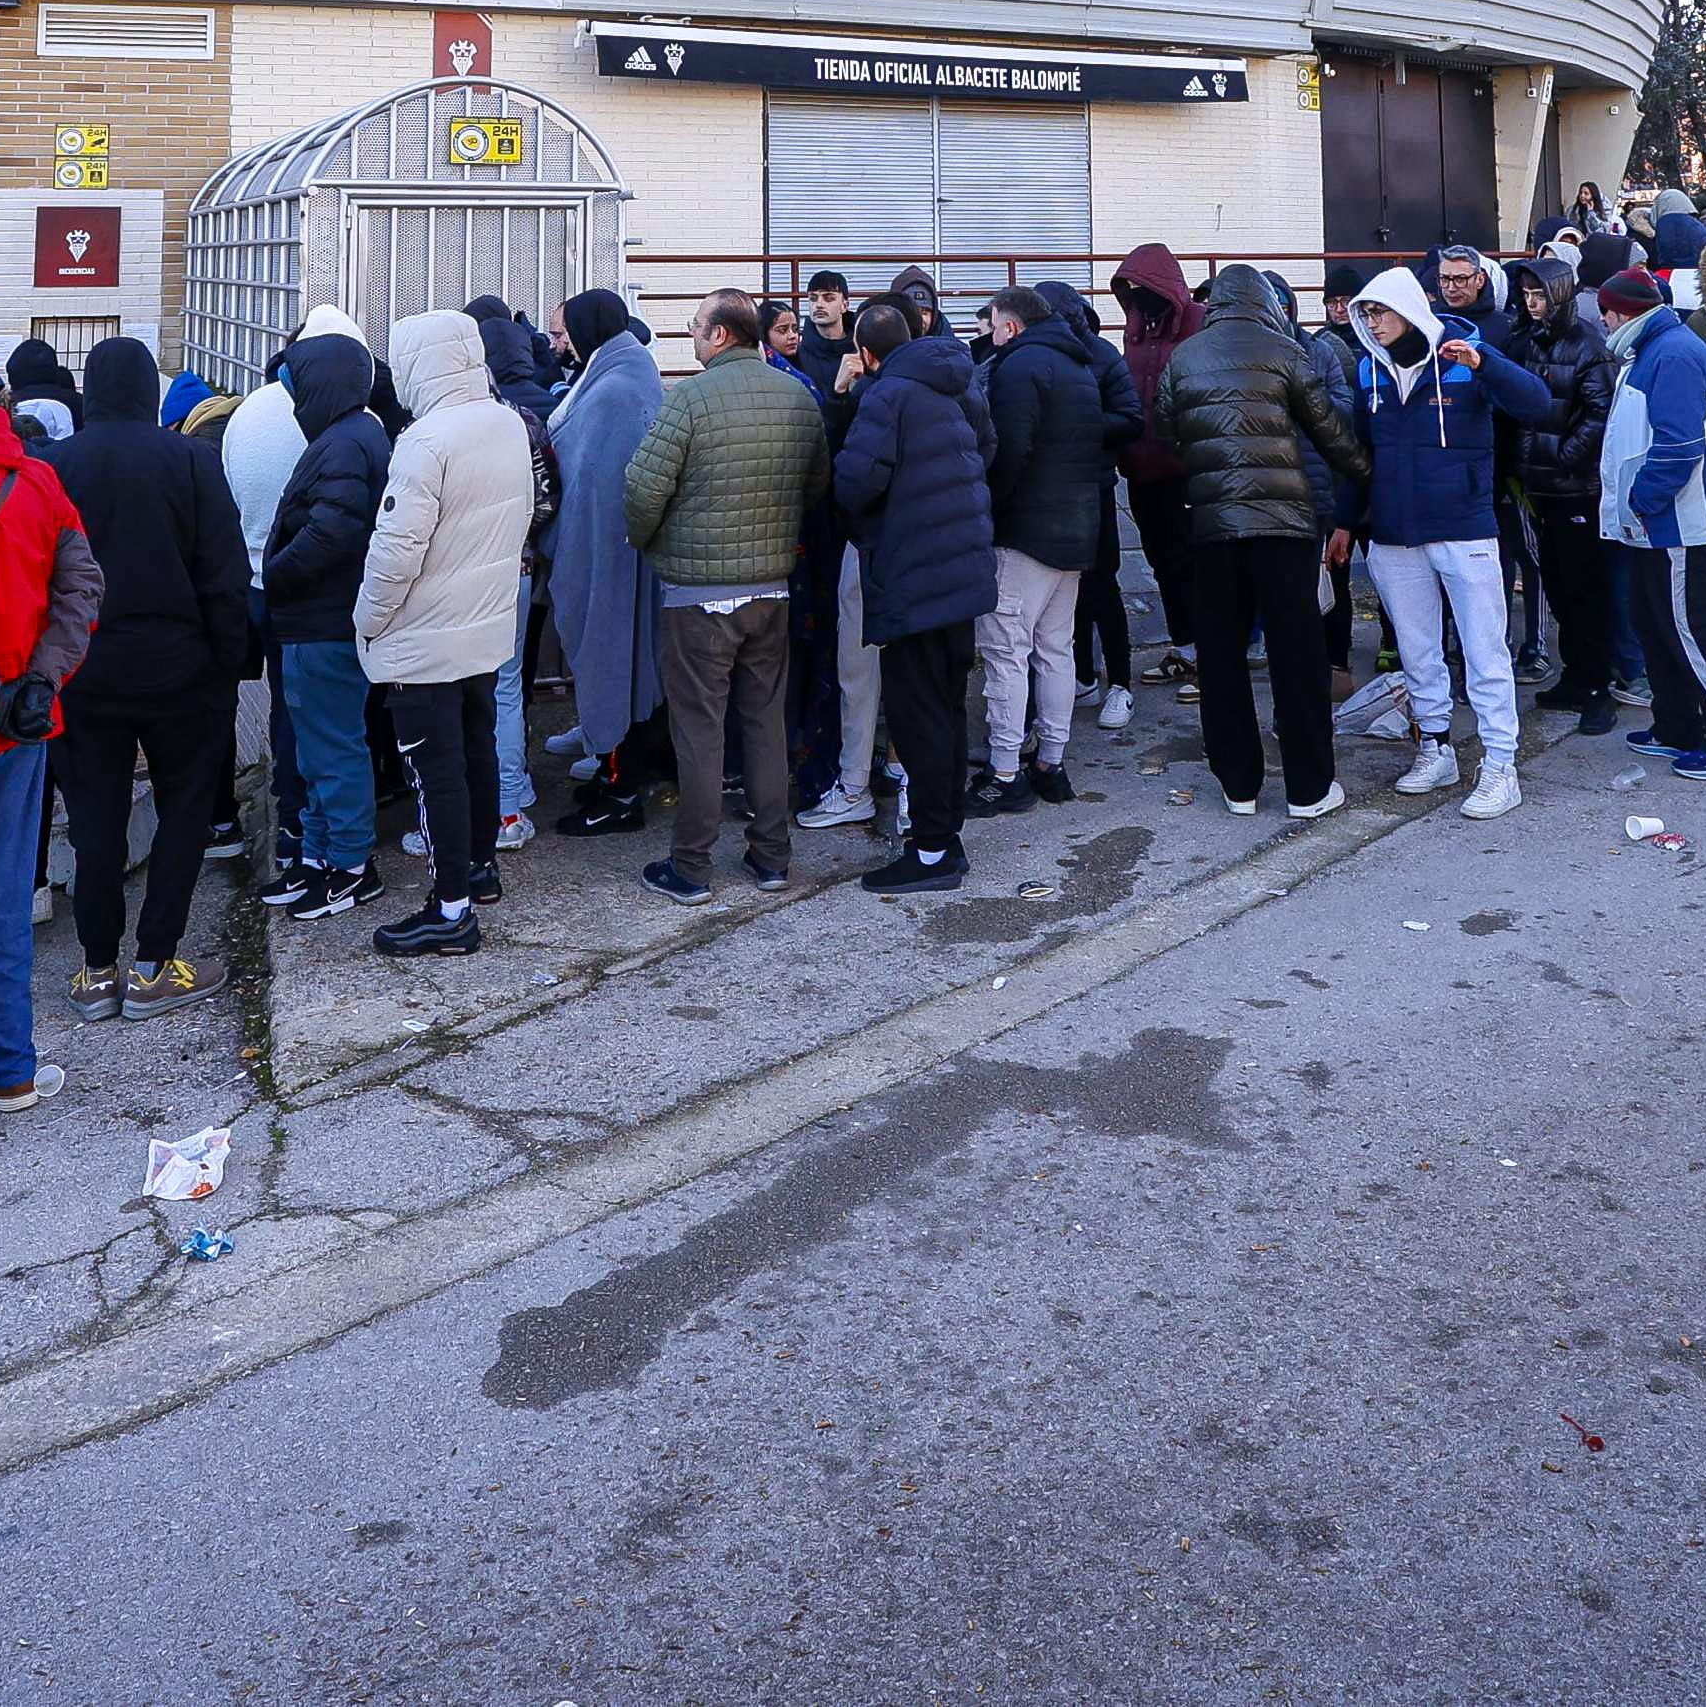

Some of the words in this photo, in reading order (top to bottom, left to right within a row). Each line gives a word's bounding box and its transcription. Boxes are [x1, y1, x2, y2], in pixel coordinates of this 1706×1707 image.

[624, 60, 658, 72] adidas
[814, 57, 871, 82] TIENDA
[874, 61, 933, 86] OFICIAL
[935, 64, 1008, 89] ALBACETE
[1011, 66, 1082, 92] BALOMPIÉ
[492, 125, 519, 136] 24H
